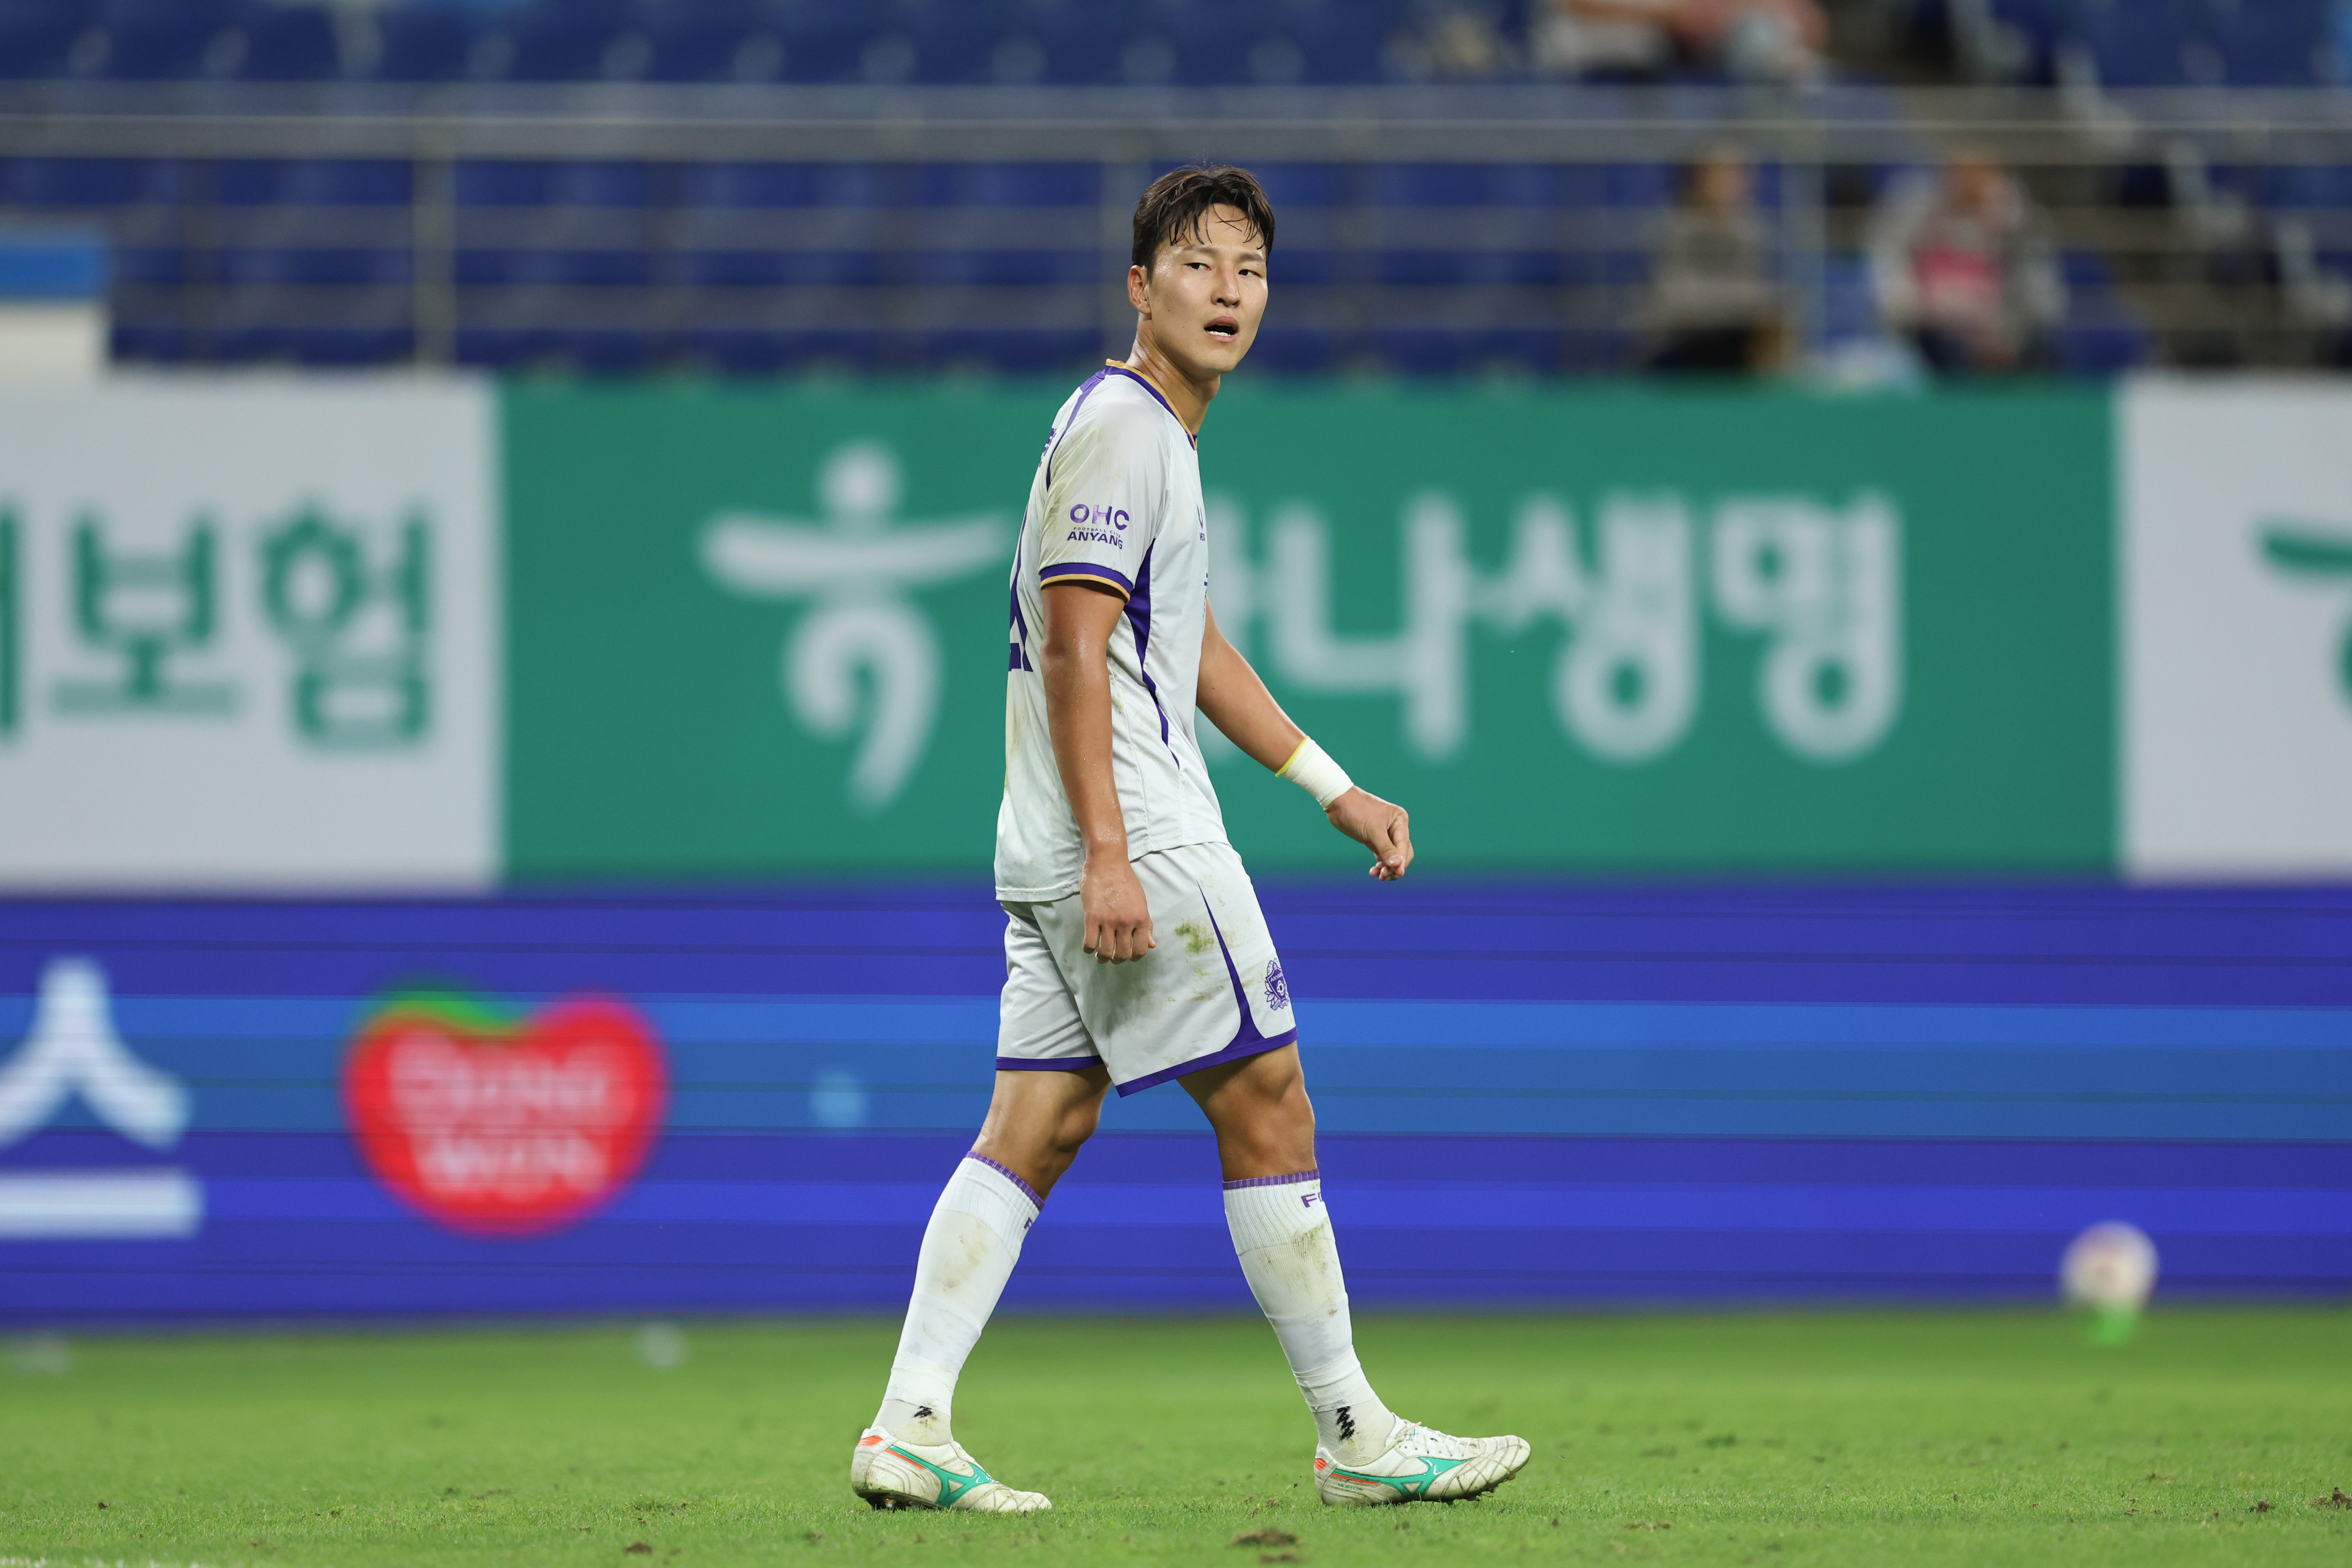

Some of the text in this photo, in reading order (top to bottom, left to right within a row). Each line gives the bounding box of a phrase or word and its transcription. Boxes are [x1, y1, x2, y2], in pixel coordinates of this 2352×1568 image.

[1070, 504, 1129, 530] OHC
[1066, 531, 1123, 550] ANYANG
[0, 497, 431, 750] 보험
